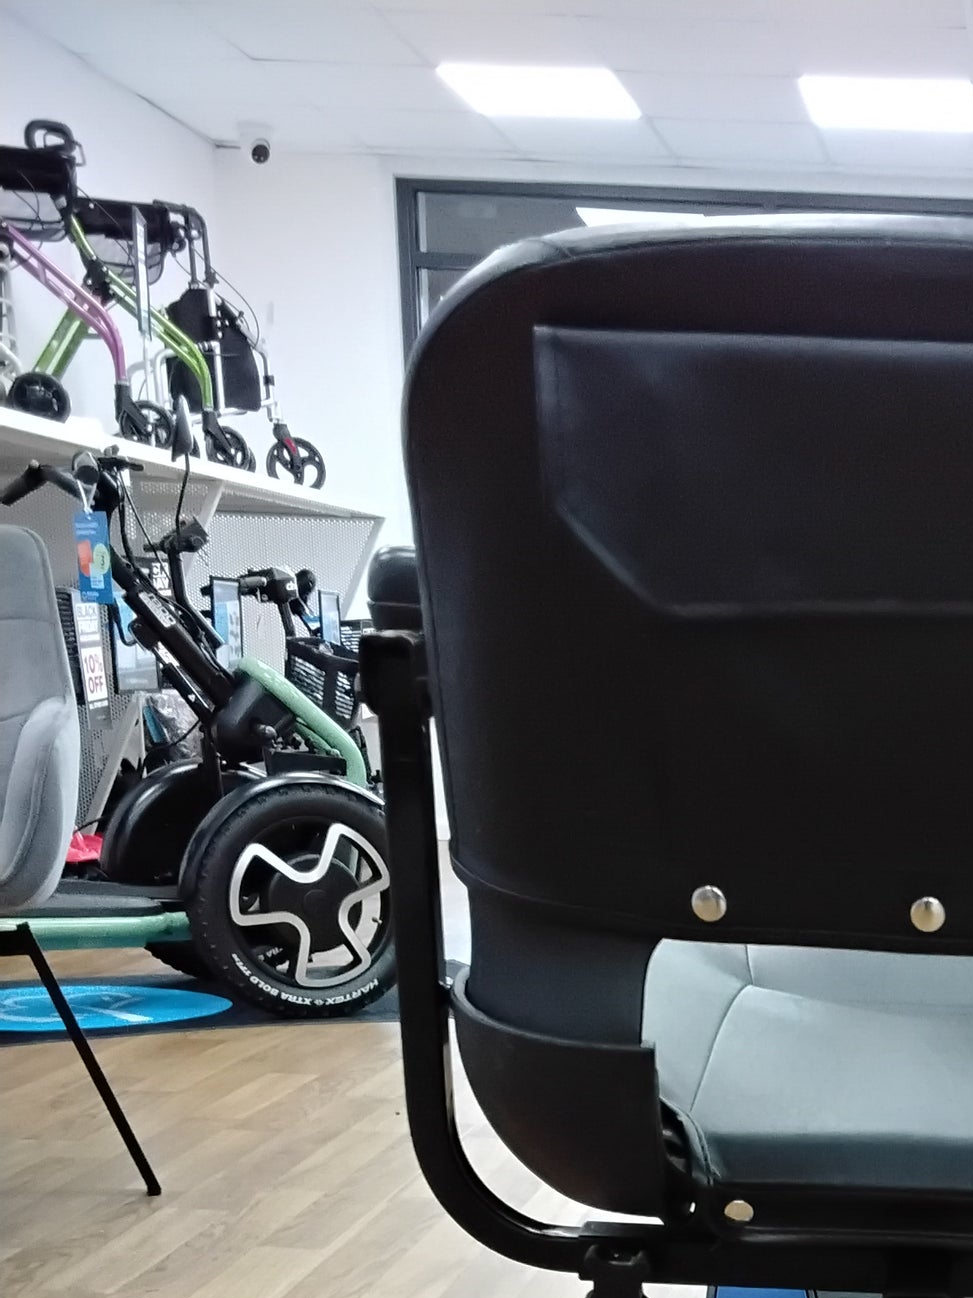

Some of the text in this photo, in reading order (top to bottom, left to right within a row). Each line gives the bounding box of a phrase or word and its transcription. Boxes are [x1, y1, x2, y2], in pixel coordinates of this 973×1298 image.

[84, 653, 103, 674] 10%
[87, 675, 104, 694] OFF
[249, 976, 280, 996] BOLD
[280, 992, 313, 1006] XTRA
